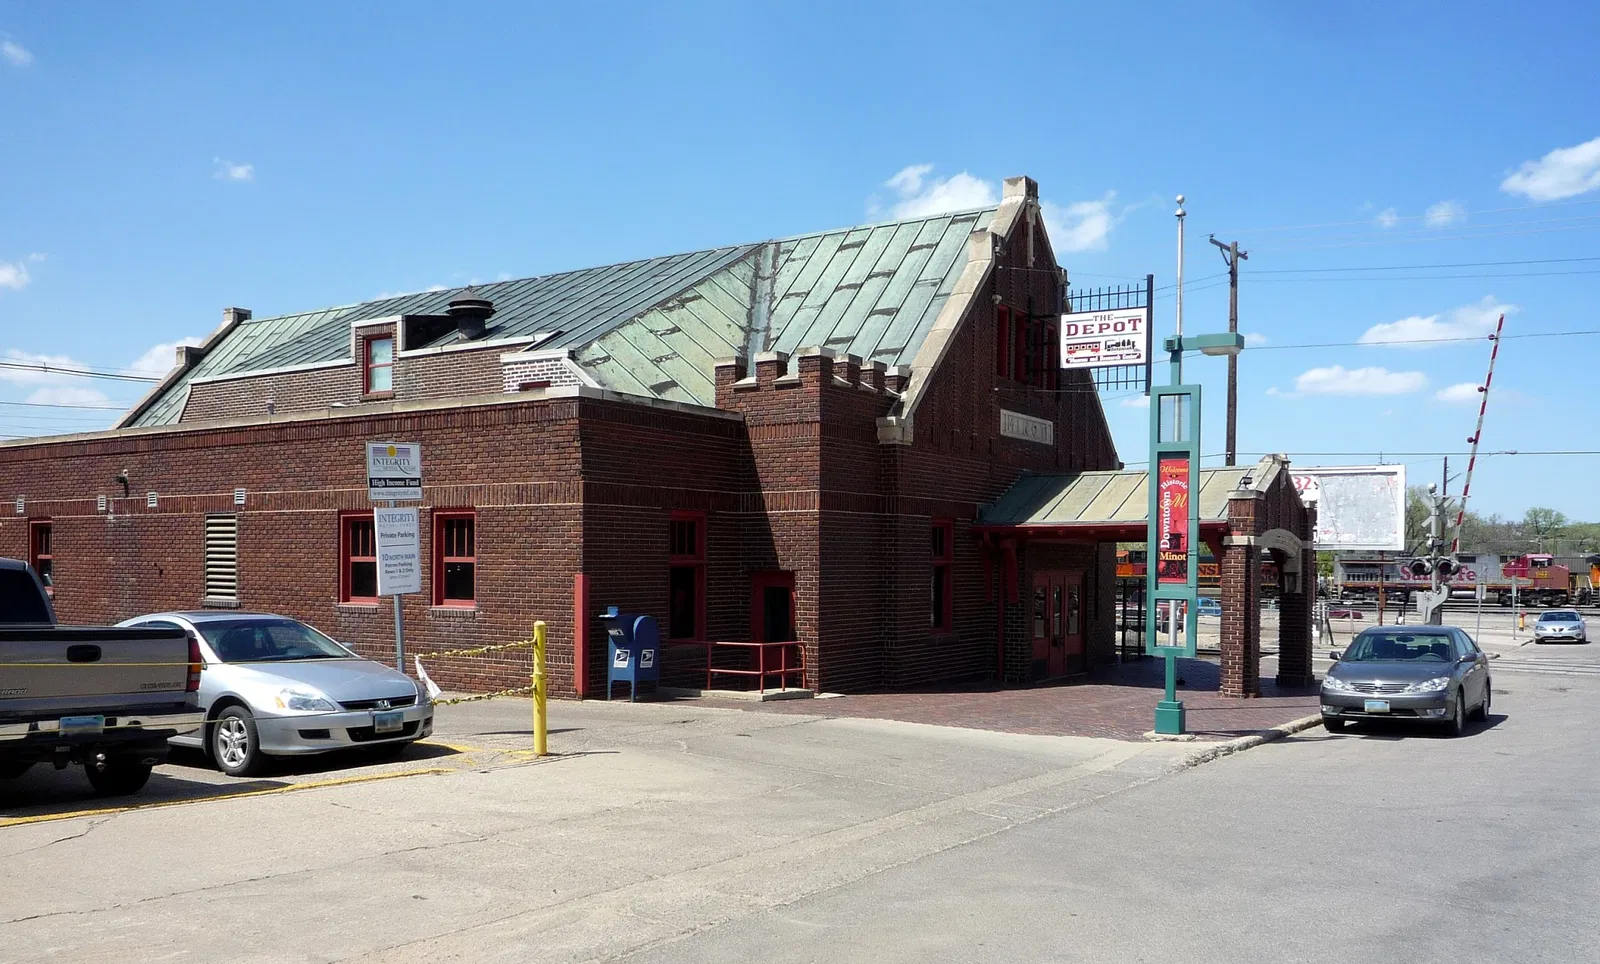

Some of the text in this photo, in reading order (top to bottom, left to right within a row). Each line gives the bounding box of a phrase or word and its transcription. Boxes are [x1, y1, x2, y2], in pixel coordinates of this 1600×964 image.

[1093, 314, 1114, 322] THE
[1066, 318, 1142, 337] DEPOT
[373, 458, 411, 467] INTEGRITY
[372, 479, 420, 488] High Income Fund
[1160, 479, 1188, 490] Historic
[379, 513, 415, 523] INTEGRITY
[1160, 491, 1171, 549] Downtown
[397, 531, 415, 539] Parking
[1160, 551, 1187, 561] Minot
